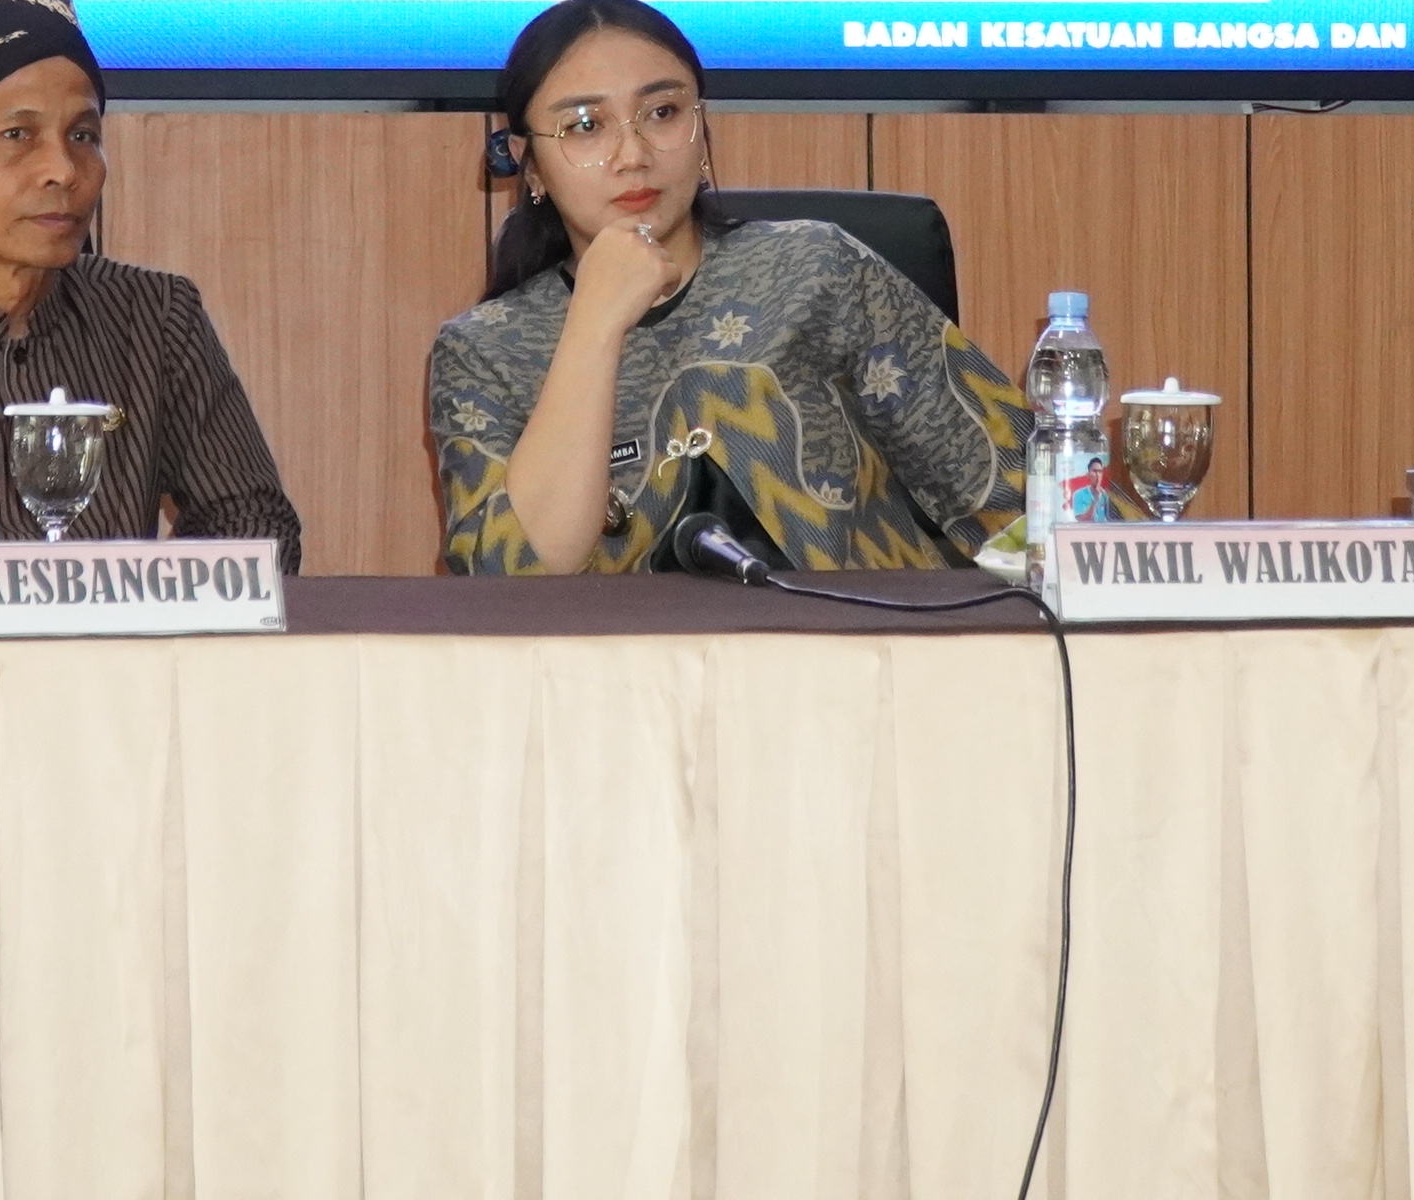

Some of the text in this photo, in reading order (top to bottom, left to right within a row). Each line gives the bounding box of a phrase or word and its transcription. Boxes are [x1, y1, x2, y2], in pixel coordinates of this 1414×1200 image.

[843, 21, 968, 48] BADAN
[981, 21, 1163, 48] KESATUAN
[1173, 22, 1320, 49] BANGSA
[1331, 22, 1406, 49] DAN
[1070, 541, 1203, 584] WAKIL
